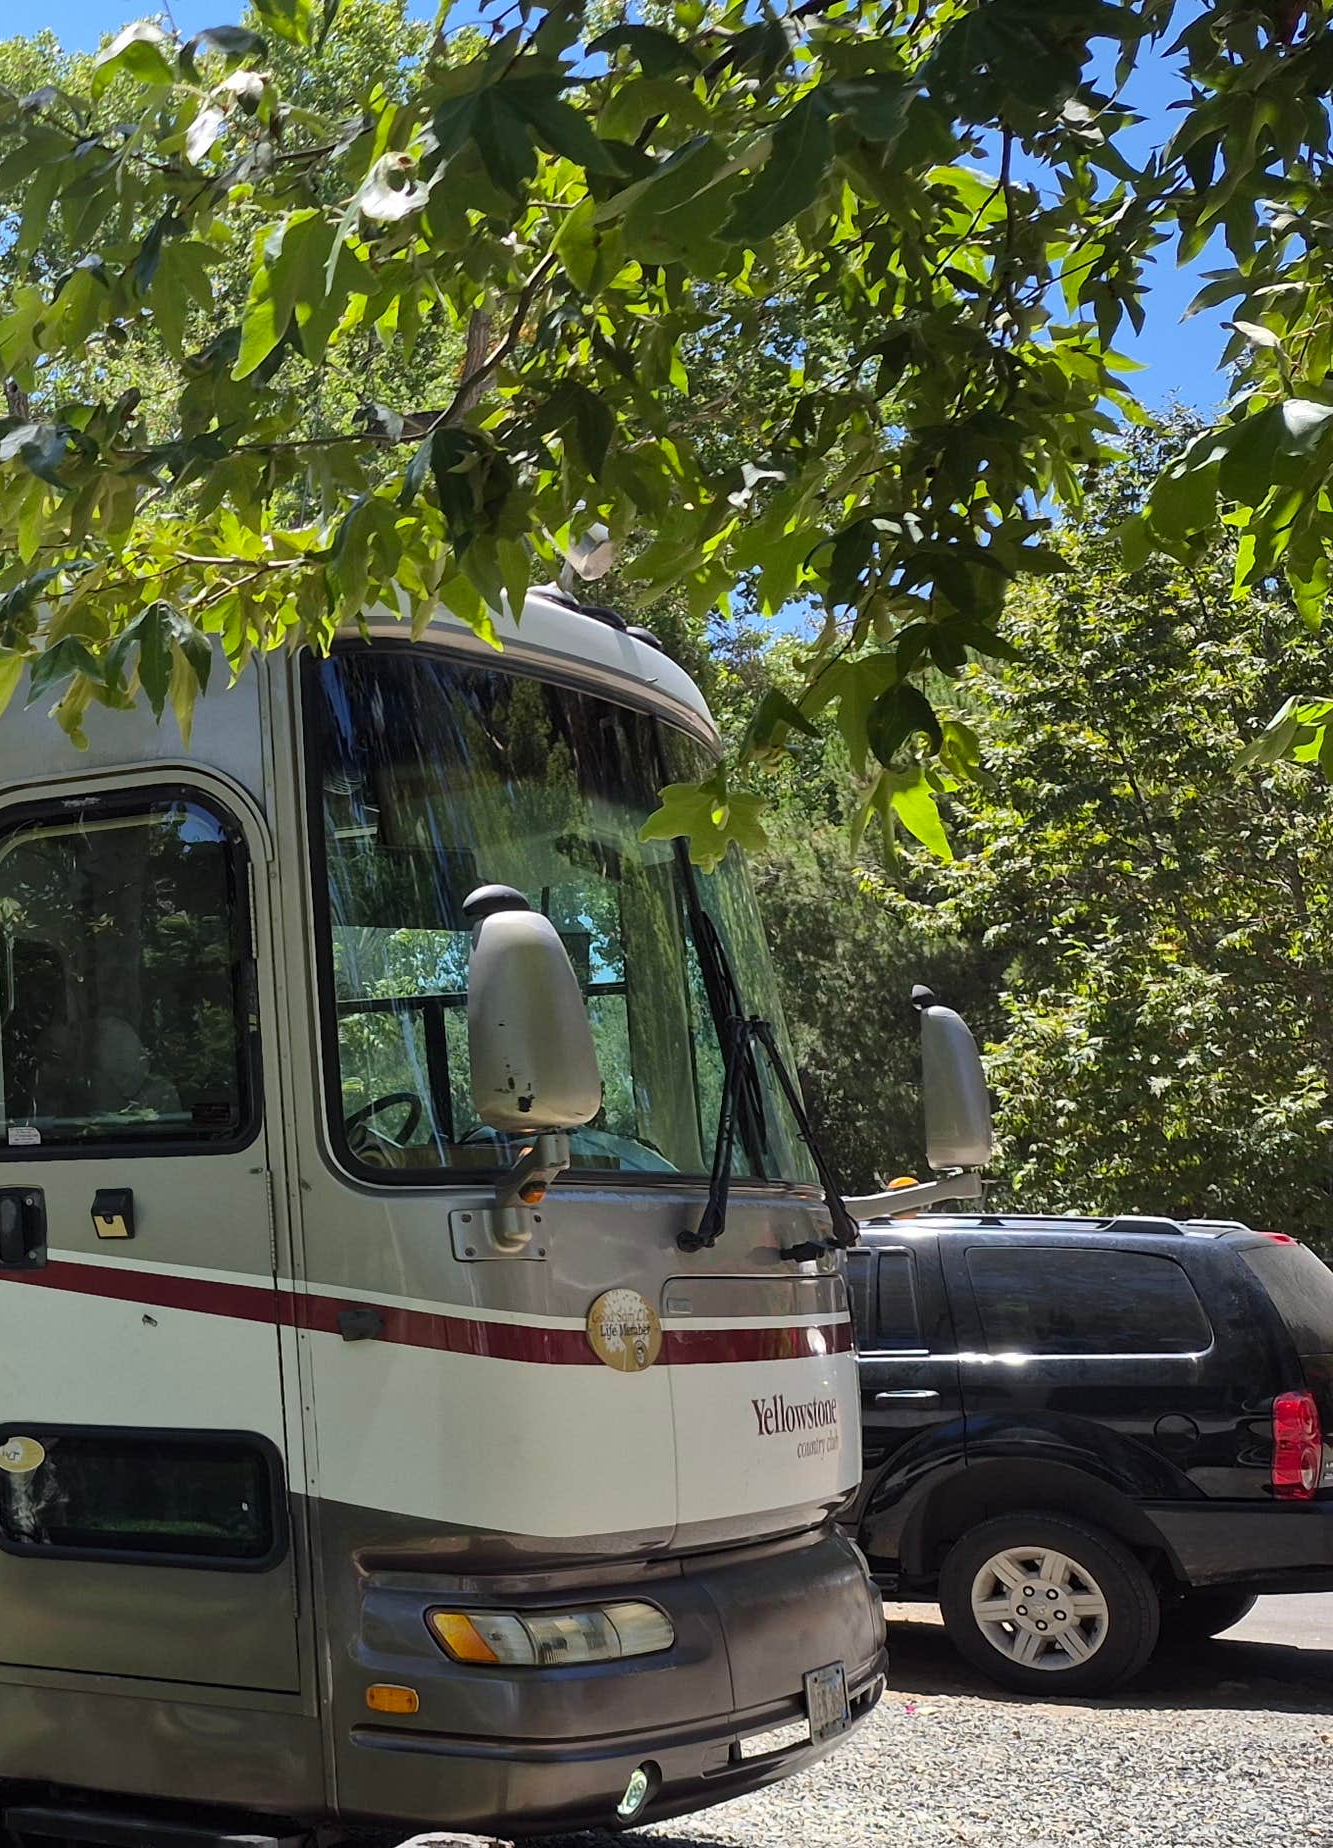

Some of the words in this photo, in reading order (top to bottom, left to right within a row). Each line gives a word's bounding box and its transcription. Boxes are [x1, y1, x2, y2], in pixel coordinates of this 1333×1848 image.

[600, 1323, 618, 1340] Life
[619, 1323, 650, 1336] Member
[751, 1393, 837, 1436] Yellowstone
[797, 1438, 825, 1461] country
